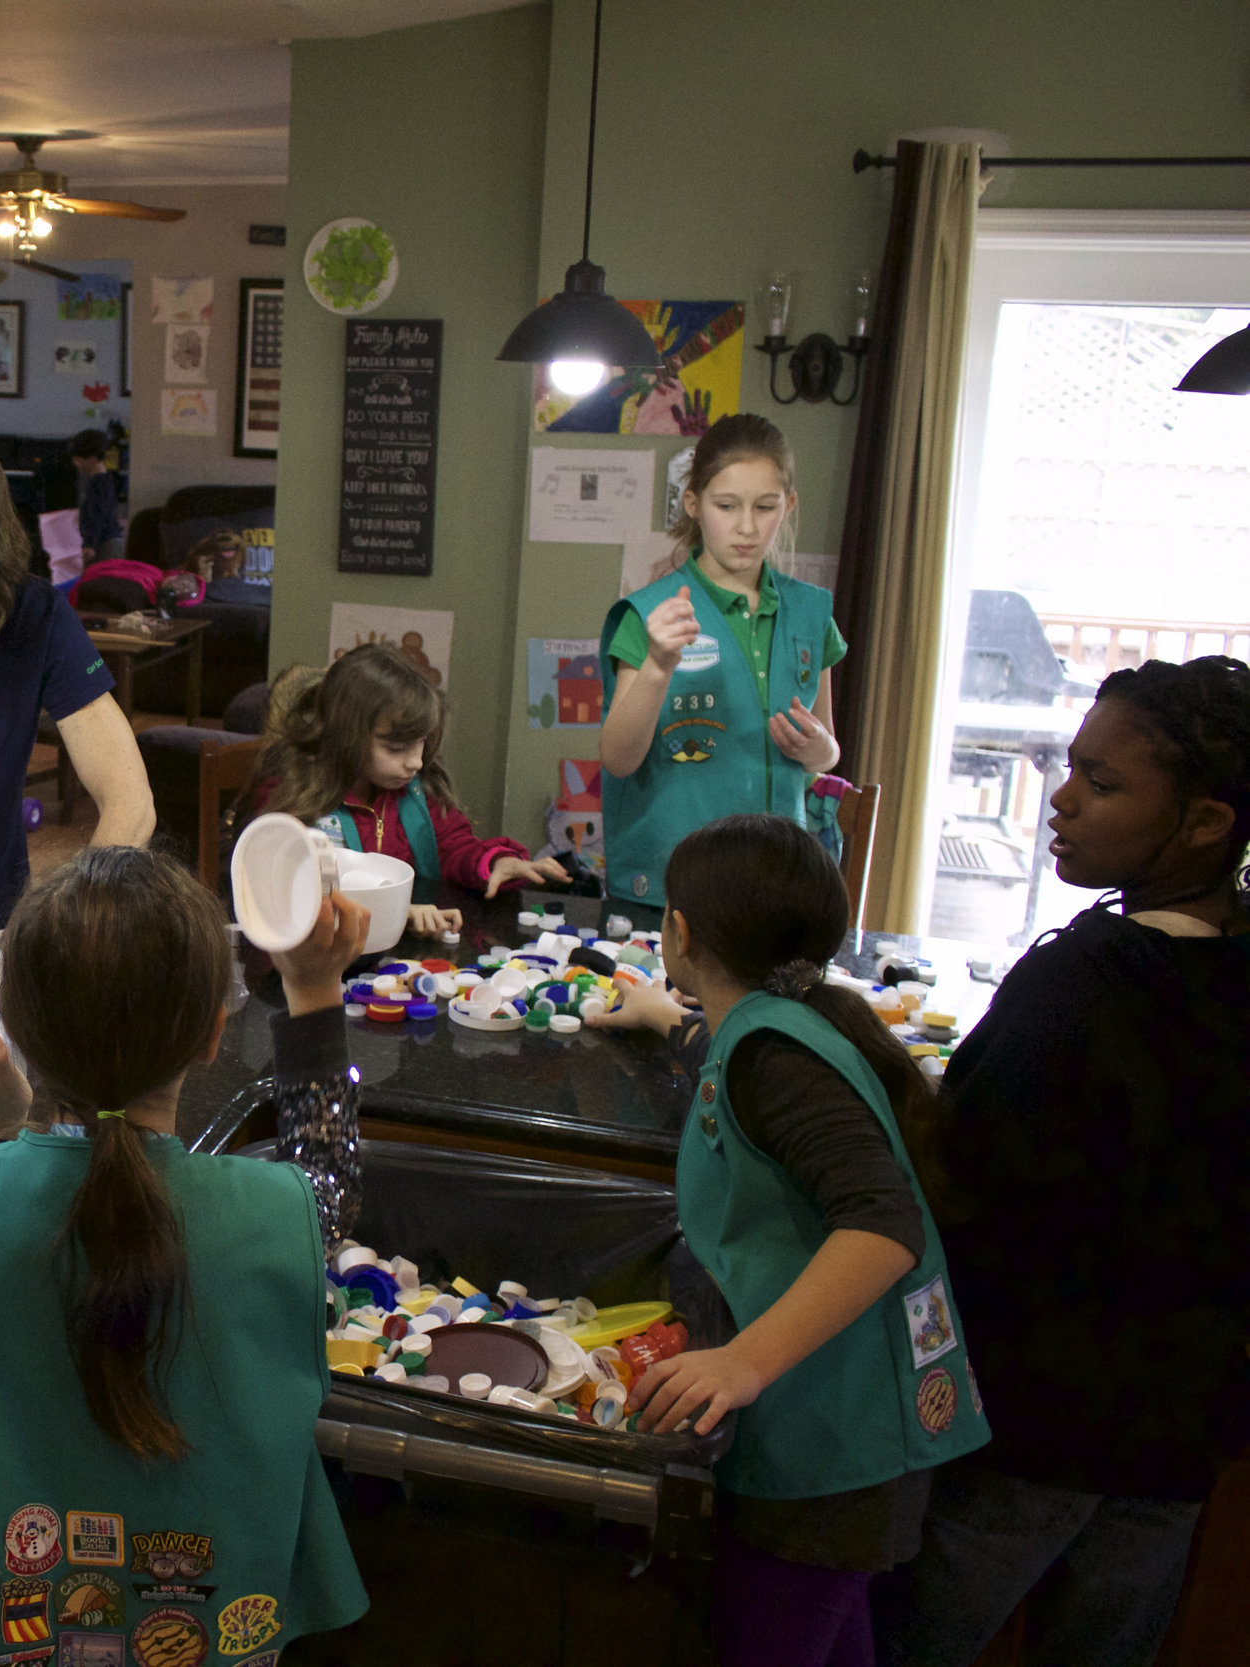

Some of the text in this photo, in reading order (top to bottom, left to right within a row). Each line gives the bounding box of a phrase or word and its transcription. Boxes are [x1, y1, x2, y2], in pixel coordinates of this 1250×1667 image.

[347, 410, 430, 424] DO YOUR BEST
[346, 448, 367, 462] SAY
[375, 449, 403, 464] LOVE
[406, 450, 429, 465] YOU
[674, 694, 715, 710] 239
[6, 1508, 35, 1540] NURSING
[36, 1508, 57, 1527] HOME
[132, 1530, 212, 1557] DANCE
[60, 1571, 120, 1596] CAMPING
[222, 1598, 272, 1626] SUPER
